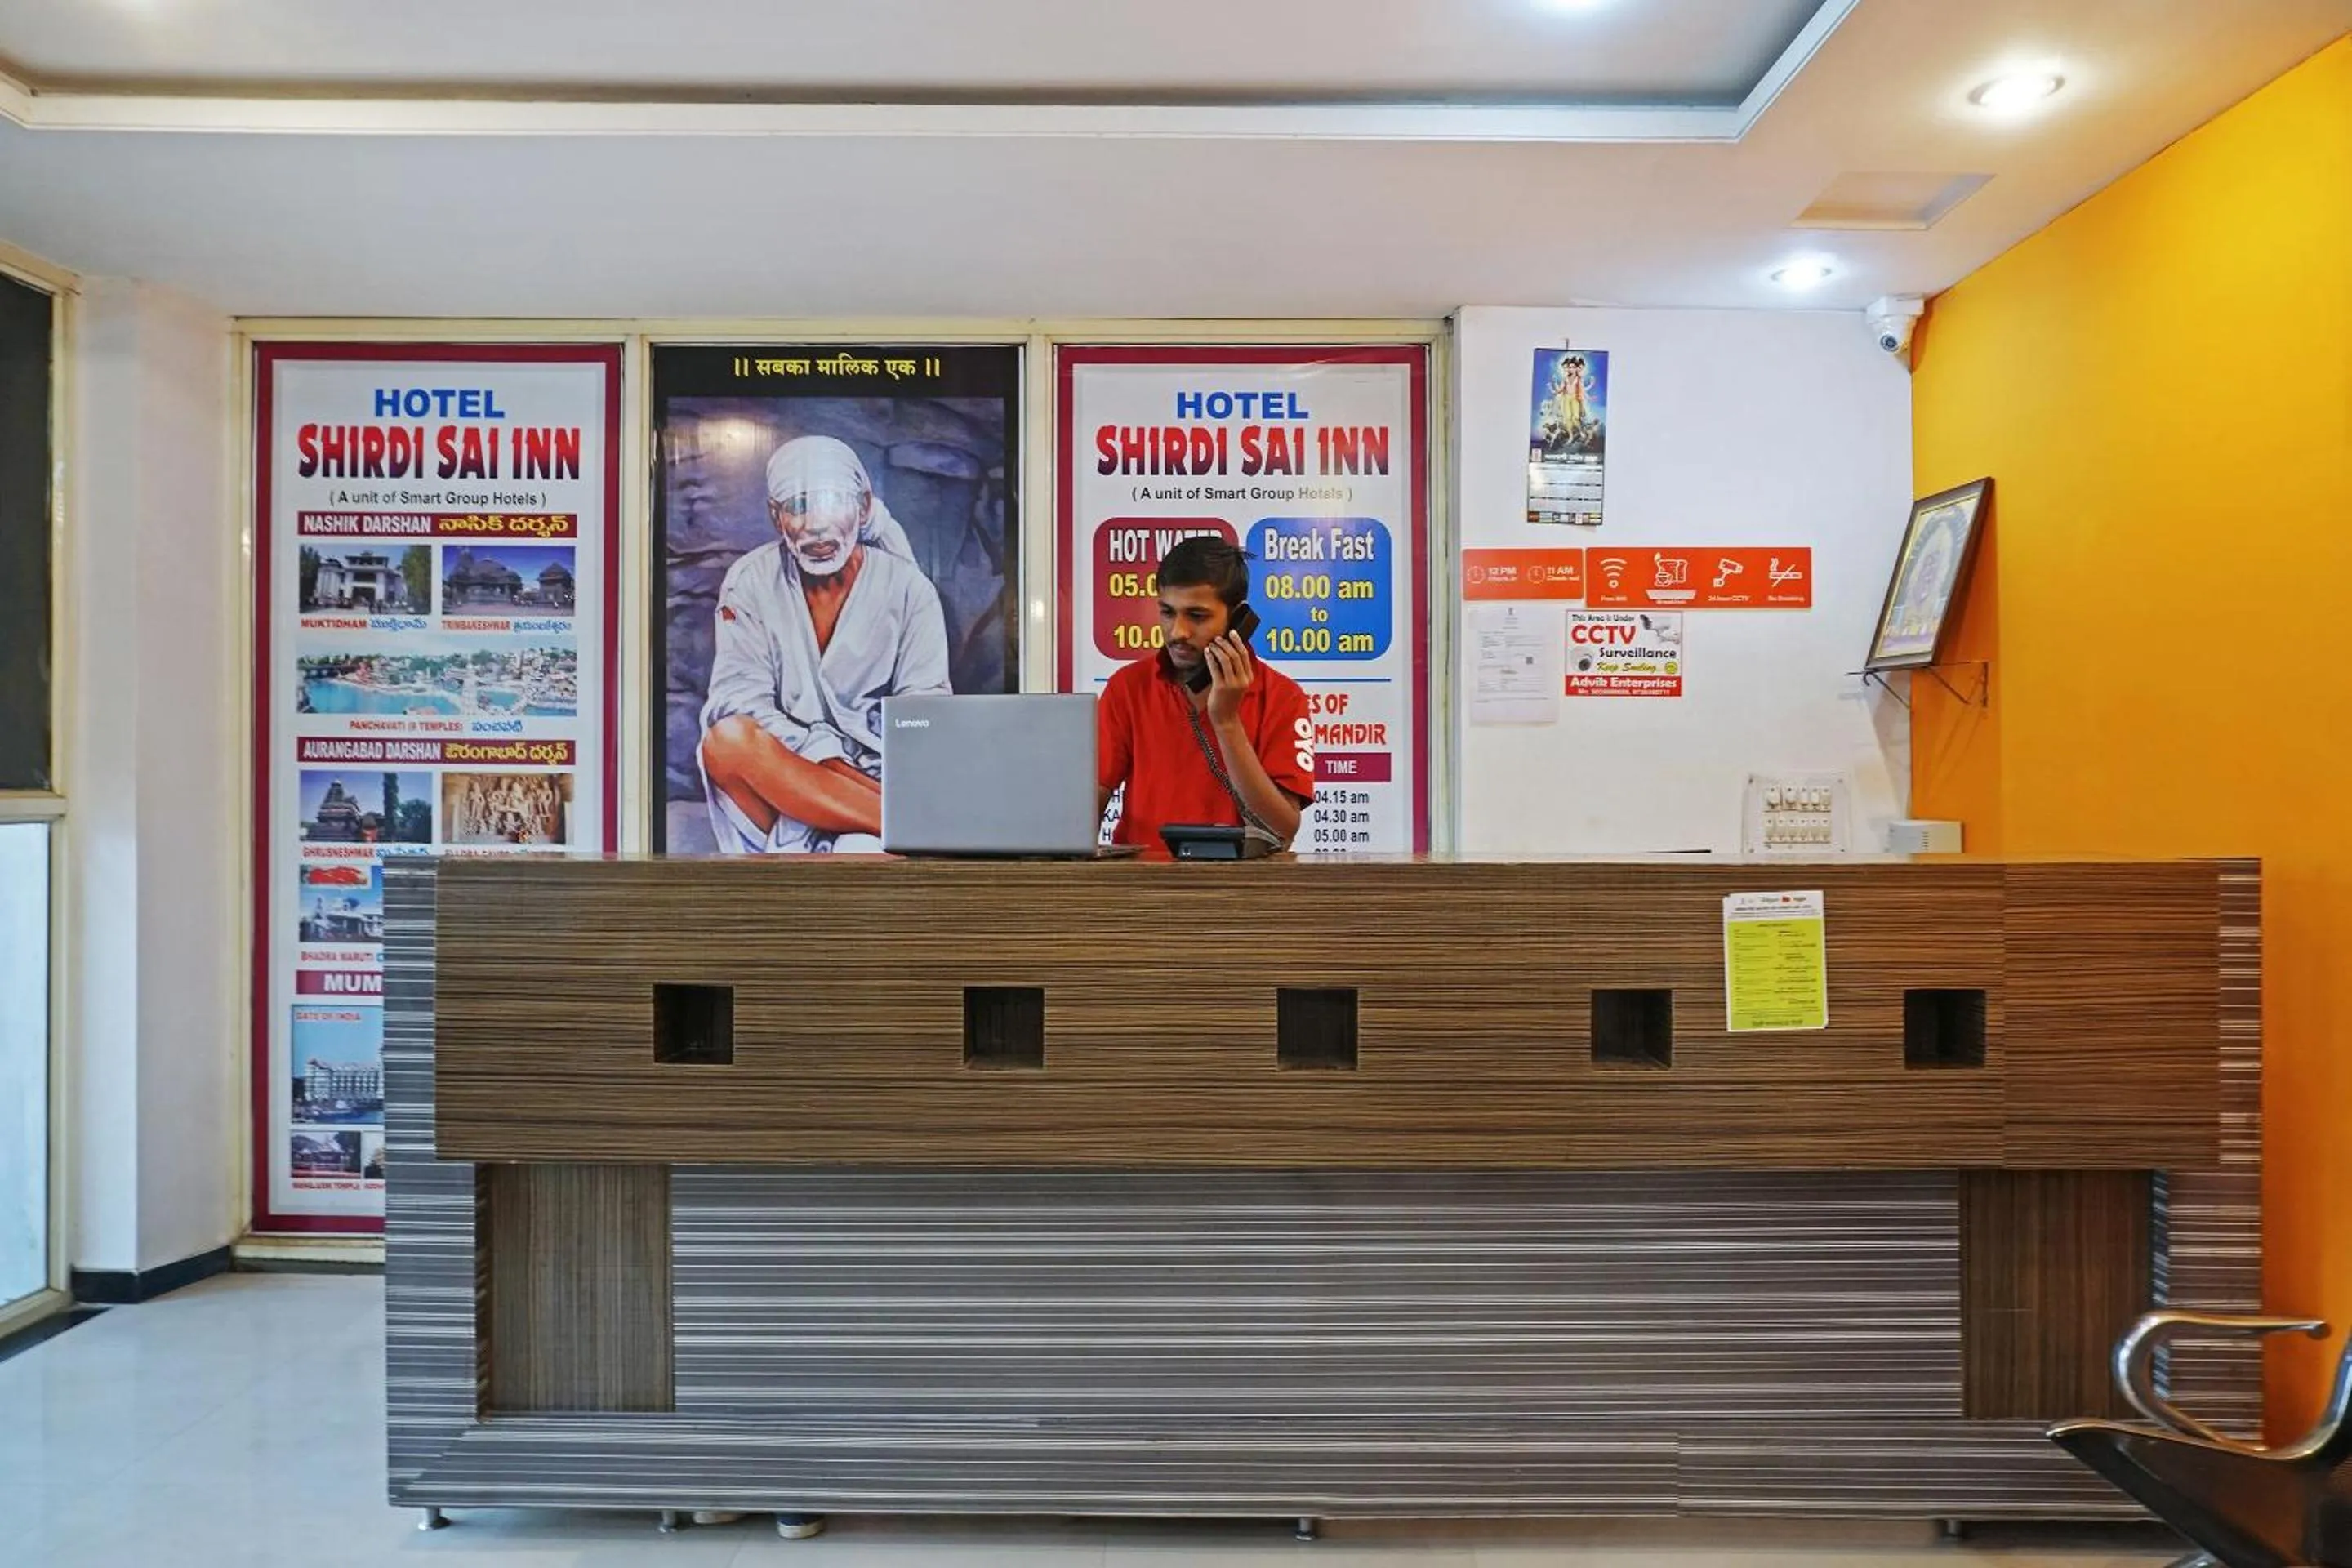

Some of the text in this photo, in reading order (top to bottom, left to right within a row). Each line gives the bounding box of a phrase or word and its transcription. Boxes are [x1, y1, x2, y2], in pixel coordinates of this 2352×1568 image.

[755, 359, 810, 376] सबका
[817, 353, 879, 376] मालिक
[884, 359, 916, 380] एक
[375, 389, 505, 418] HOTEL
[1177, 392, 1309, 419] HOTEL
[297, 424, 580, 480] SHIRDI SAI INN
[1096, 425, 1388, 477] SHIRDI SAI INN
[337, 490, 349, 503] A
[352, 491, 378, 503] unit
[382, 491, 397, 503] of
[400, 491, 441, 504] Smart
[446, 492, 488, 506] Group
[493, 492, 537, 505] Hotels
[1141, 488, 1152, 499] A
[1156, 488, 1182, 499] unit
[1187, 487, 1200, 499] of
[1205, 488, 1245, 499] Smart
[1250, 488, 1294, 501] Group
[1298, 487, 1343, 499] Hotels
[304, 514, 432, 533] NASHIK DARSHAN
[1109, 529, 1150, 562] HOT
[1264, 528, 1374, 560] Break Fast
[1500, 566, 1517, 575] PM
[1557, 566, 1574, 574] AM
[1266, 574, 1374, 599] 08.00 am
[300, 618, 368, 628] MUKTIDHAM
[1310, 606, 1328, 621] to
[1267, 628, 1374, 653] 10.00 am
[1571, 625, 1636, 644] CCTV
[1599, 648, 1677, 658] Surveillance
[1610, 677, 1677, 688] Enterprises
[1325, 694, 1349, 715] OF
[895, 719, 929, 728] Lenovo
[1314, 724, 1386, 746] MANDIR
[303, 741, 442, 760] AURANGABAD DARSHAN
[1294, 717, 1314, 773] OYO
[1325, 760, 1357, 774] TIME
[1314, 790, 1370, 804] 04.15 am
[1314, 809, 1370, 822] 04.30 am
[1314, 829, 1370, 842] 05.00 am
[323, 973, 383, 991] MUM
